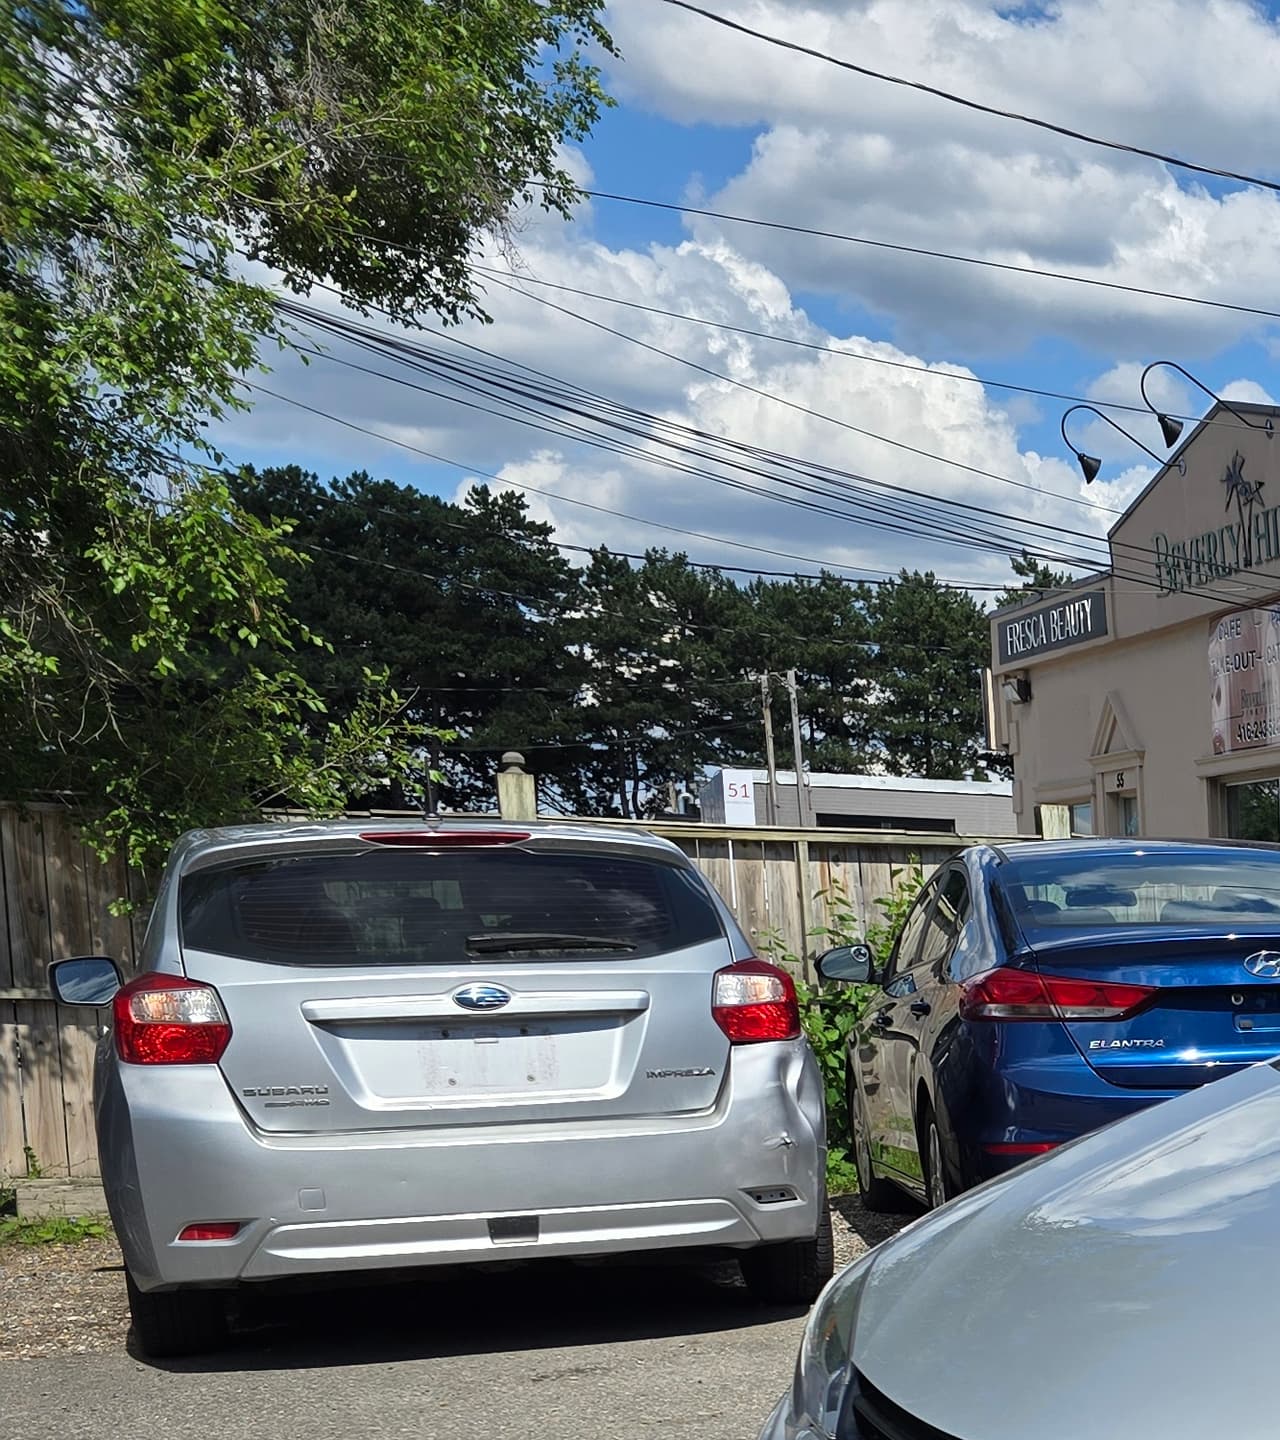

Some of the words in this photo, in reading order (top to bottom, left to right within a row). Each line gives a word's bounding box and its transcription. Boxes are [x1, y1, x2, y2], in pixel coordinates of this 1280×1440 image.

[1153, 521, 1242, 598] BEVERLY
[1006, 614, 1047, 655] FRESCA
[1049, 599, 1092, 643] BEAUTY
[1218, 617, 1242, 642] CAFE
[727, 783, 750, 799] 51
[1089, 1039, 1166, 1049] ELANTRA
[645, 1066, 716, 1080] IMPREZA
[242, 1084, 329, 1097] SUBARU
